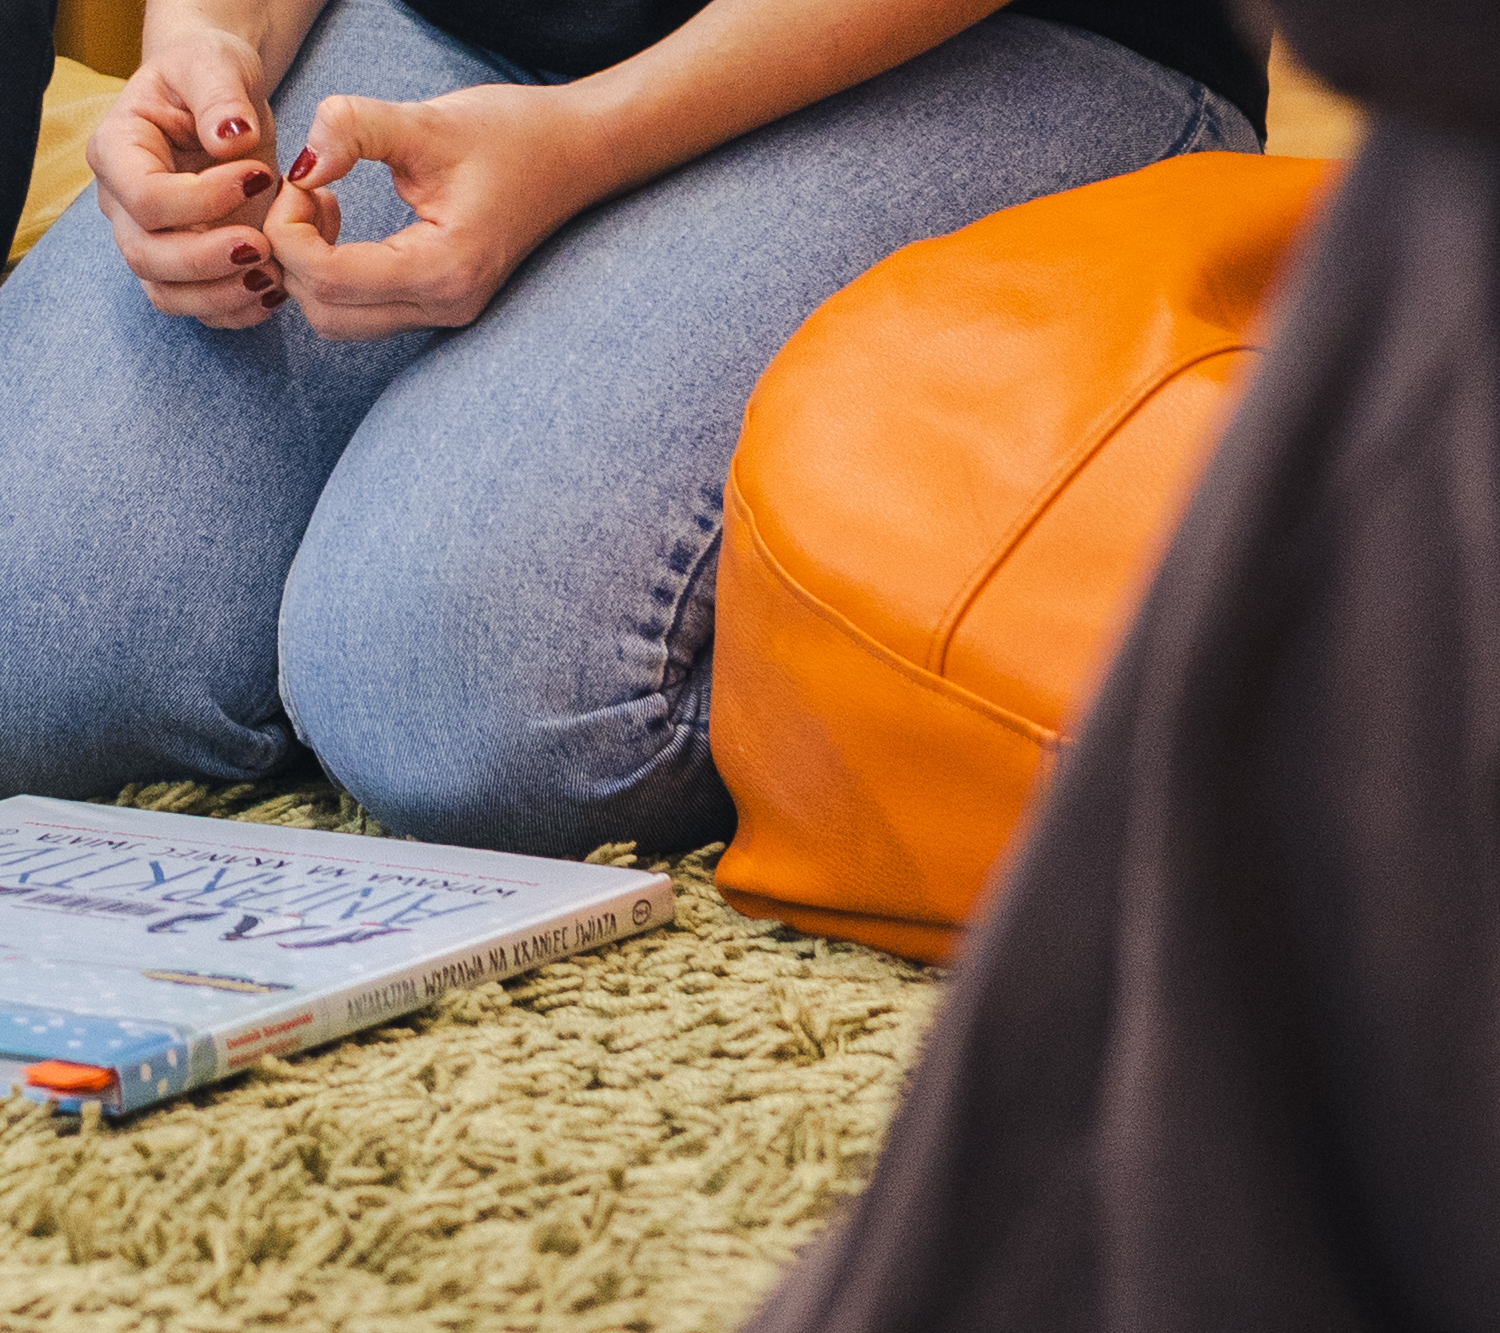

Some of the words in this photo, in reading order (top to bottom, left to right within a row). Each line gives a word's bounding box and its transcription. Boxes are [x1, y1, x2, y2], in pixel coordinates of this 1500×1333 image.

[149, 846, 294, 871] KRANIEC
[306, 864, 357, 879] NA
[366, 873, 518, 899] WYPRAWA
[422, 953, 485, 998] WYPRAWA
[488, 946, 508, 973] NA
[512, 924, 570, 968] KRANIEC
